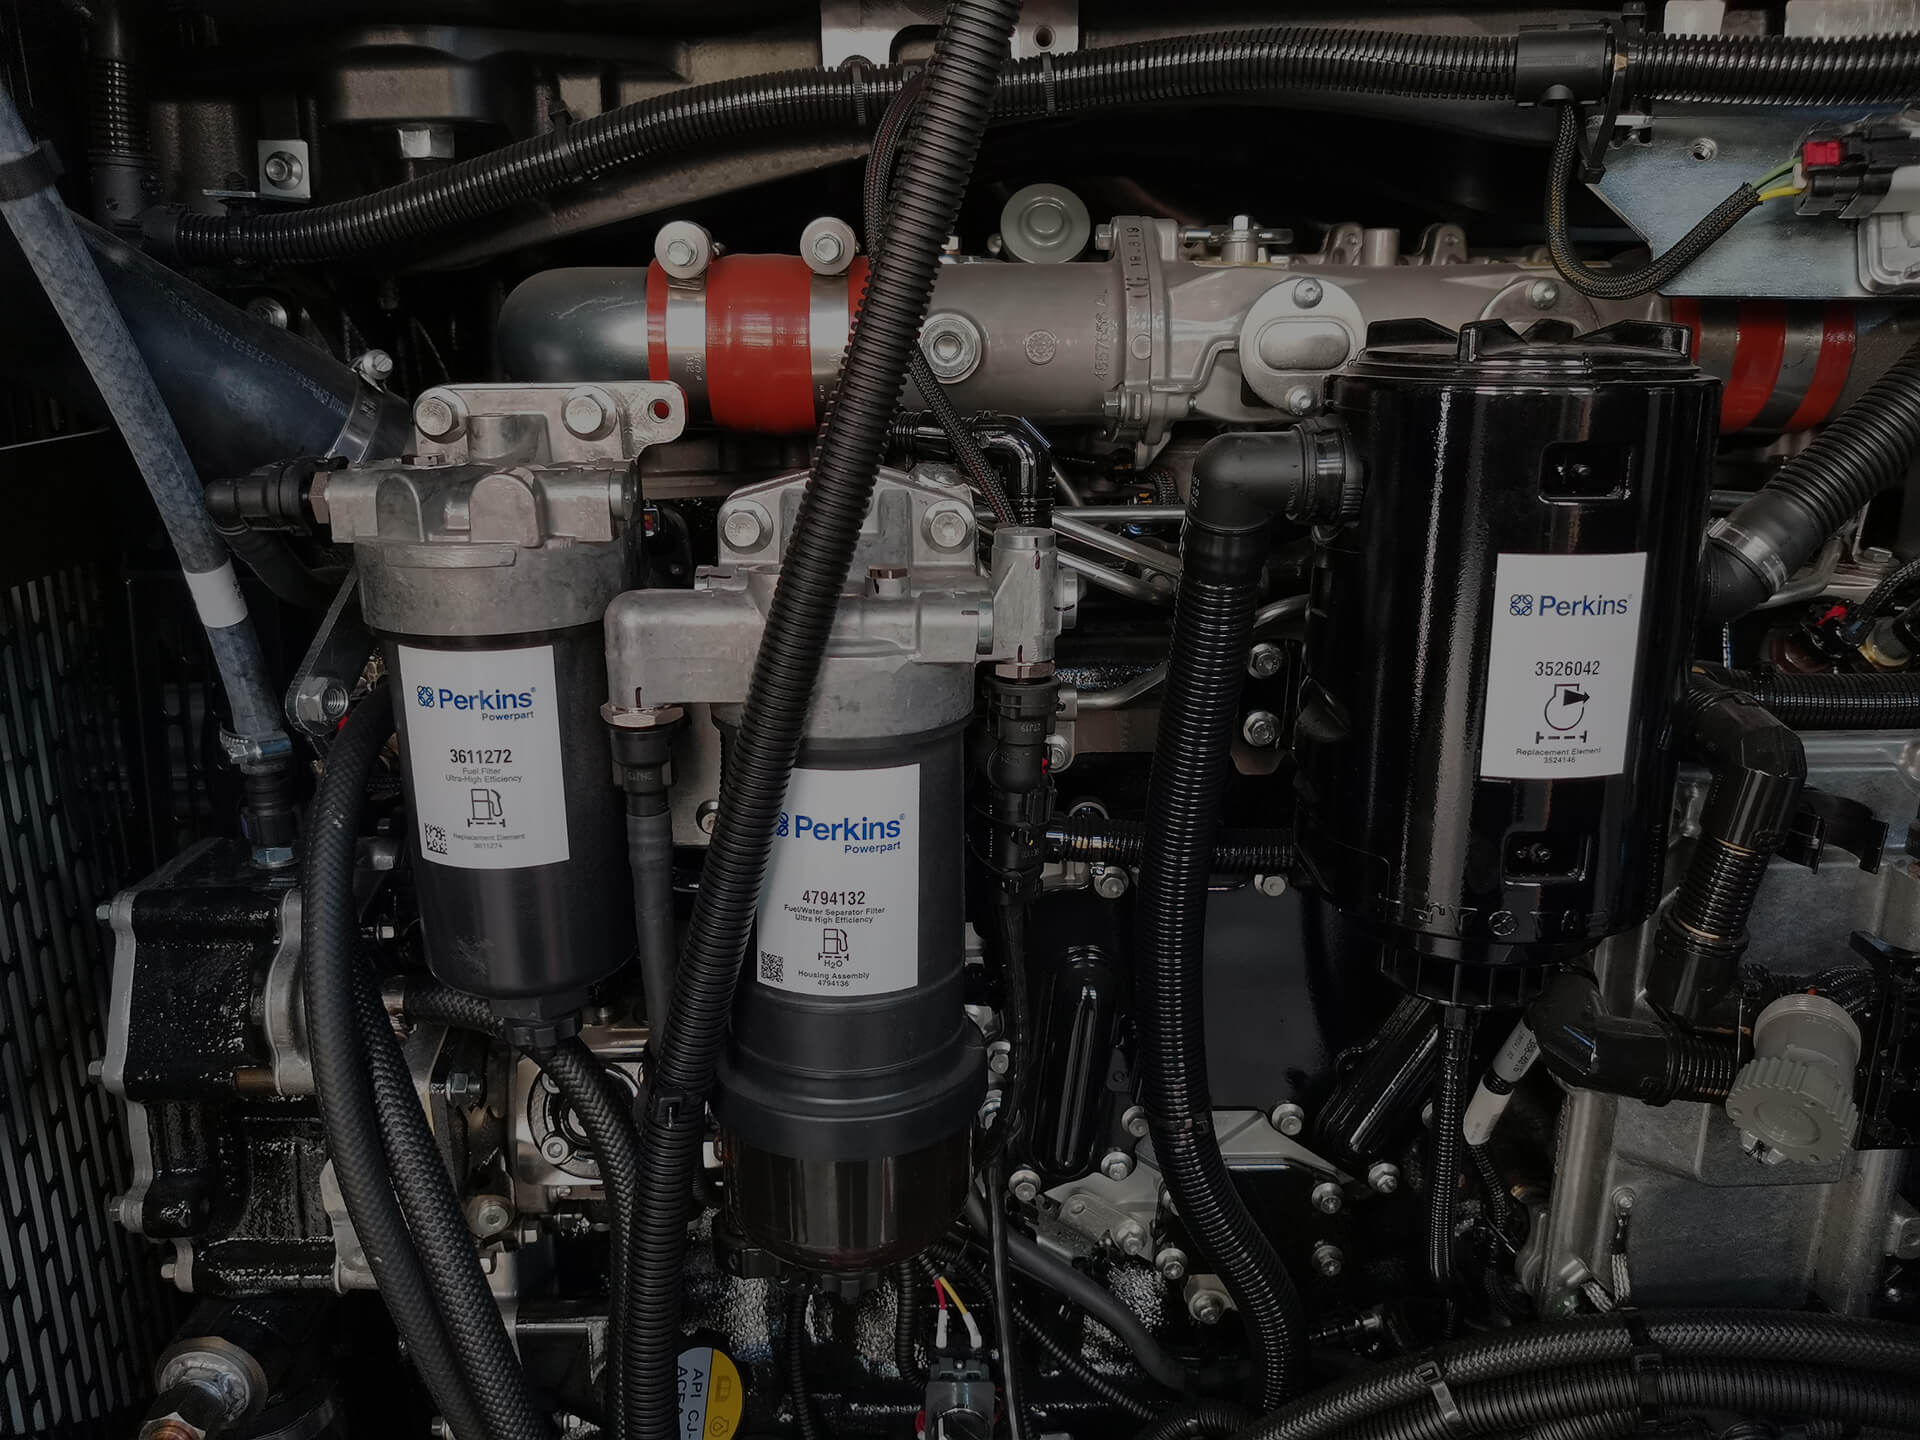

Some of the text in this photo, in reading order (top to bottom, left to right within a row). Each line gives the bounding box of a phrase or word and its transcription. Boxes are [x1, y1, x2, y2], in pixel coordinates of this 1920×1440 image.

[1538, 594, 1628, 616] Perkins
[1535, 660, 1601, 676] 3526042
[438, 688, 532, 710] Perkins
[481, 711, 535, 722] Powerpart
[449, 748, 513, 765] 3611272
[1515, 747, 1601, 758] Replacement Element
[462, 767, 502, 775] Fuel Filter
[445, 774, 523, 784] Ultra-High Efficiency
[795, 814, 901, 841] Perkins
[452, 832, 526, 841] Replacement Element
[844, 841, 901, 855] Powerpart
[802, 890, 866, 906] 4794132
[784, 904, 886, 917] Fuel/Water Separator Filter
[795, 914, 874, 924] Ultra High Efficiency
[798, 970, 870, 981] Housing Assembly
[690, 1368, 702, 1397] API
